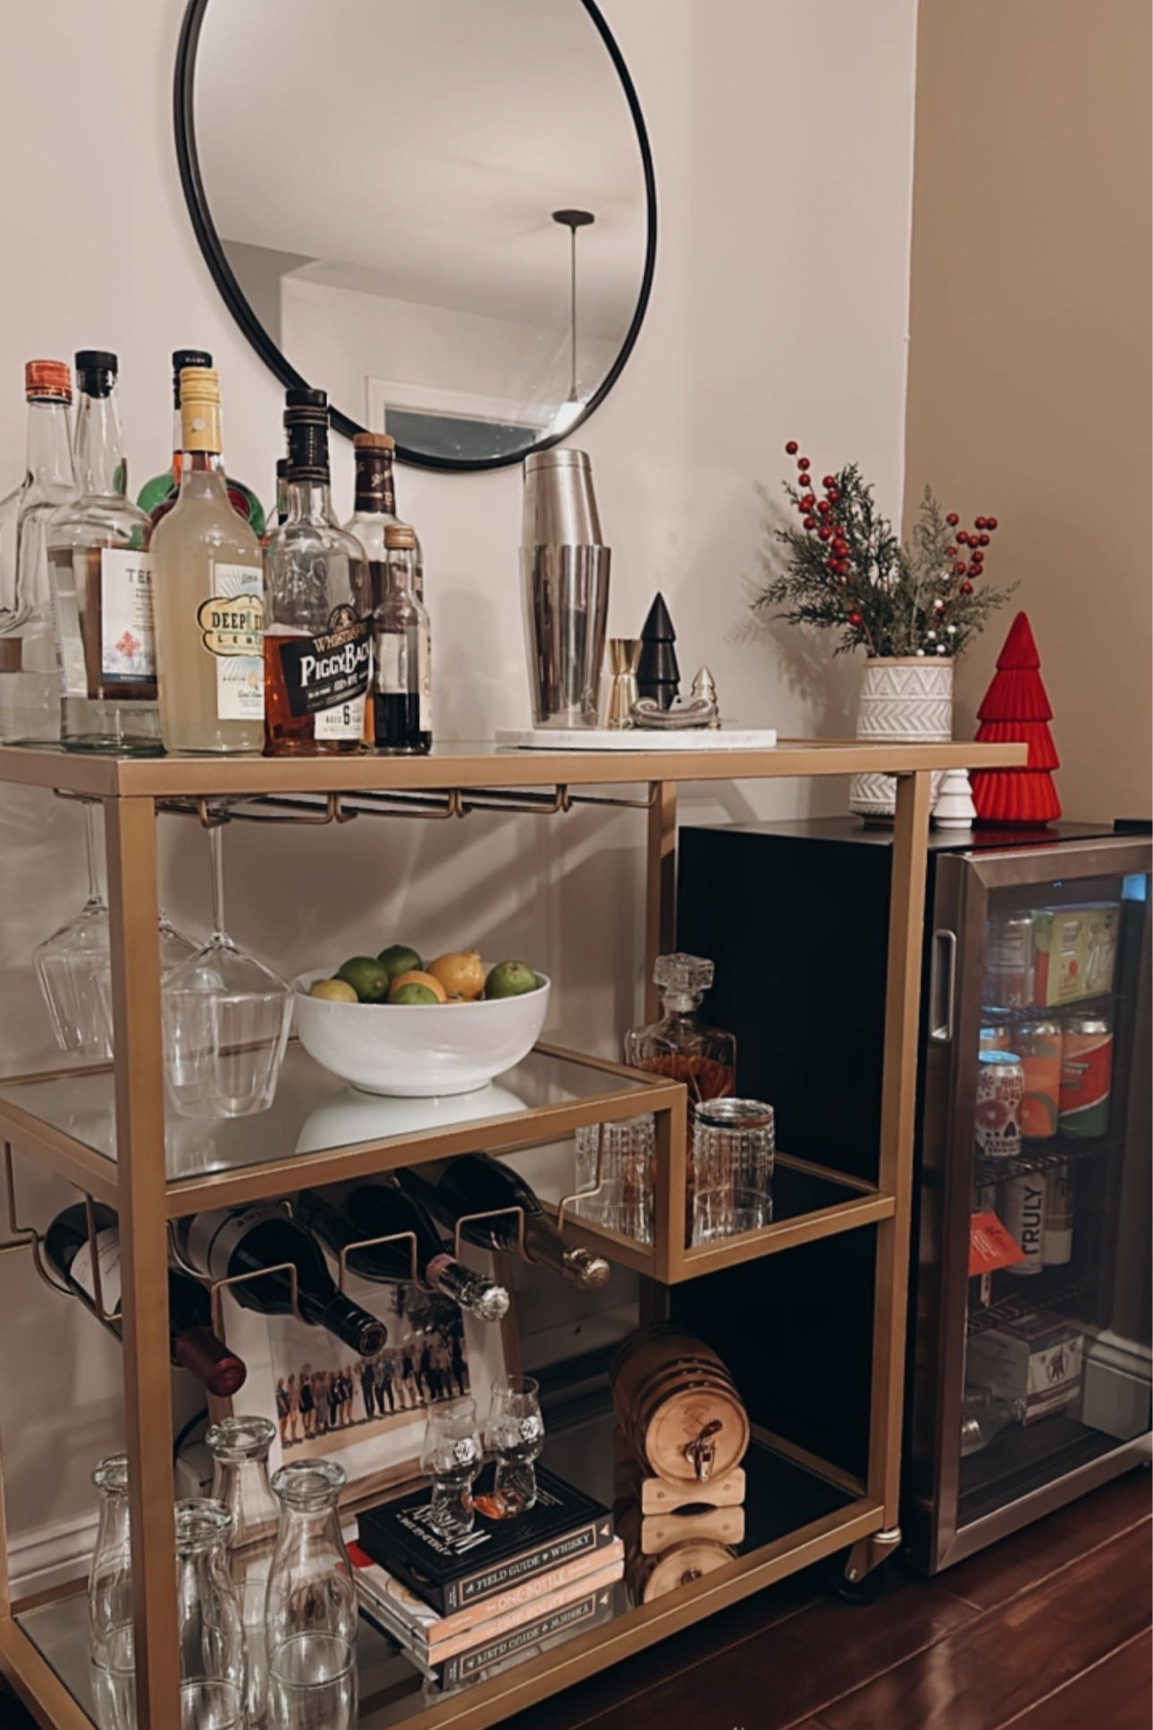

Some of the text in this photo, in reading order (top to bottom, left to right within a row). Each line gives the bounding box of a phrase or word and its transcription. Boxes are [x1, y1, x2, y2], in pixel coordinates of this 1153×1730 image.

[211, 612, 246, 629] DEEP
[343, 705, 350, 725] 6
[1021, 1186, 1042, 1255] TRULY
[476, 1570, 507, 1591] FIELD
[508, 1557, 540, 1580] GUIDE
[551, 1533, 591, 1557] WHISKY
